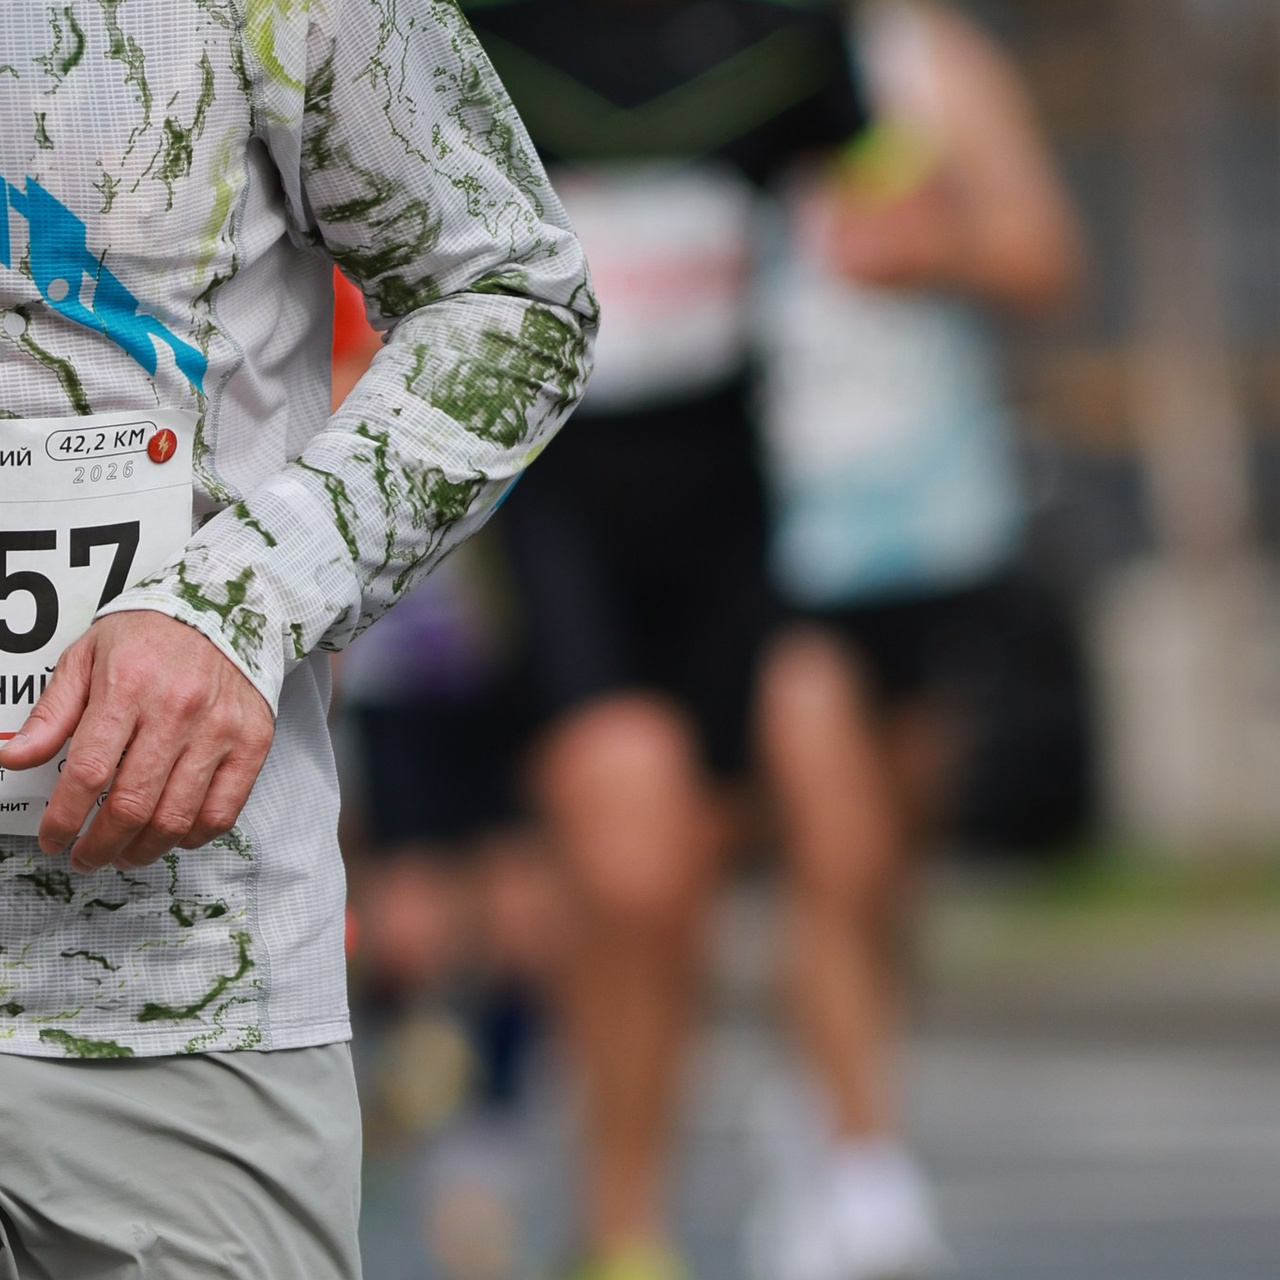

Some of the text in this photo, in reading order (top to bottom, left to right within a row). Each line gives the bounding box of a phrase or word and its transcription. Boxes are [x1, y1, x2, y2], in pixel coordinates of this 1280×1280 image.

[59, 428, 145, 455] 42,2 КМ
[72, 461, 134, 484] 2026
